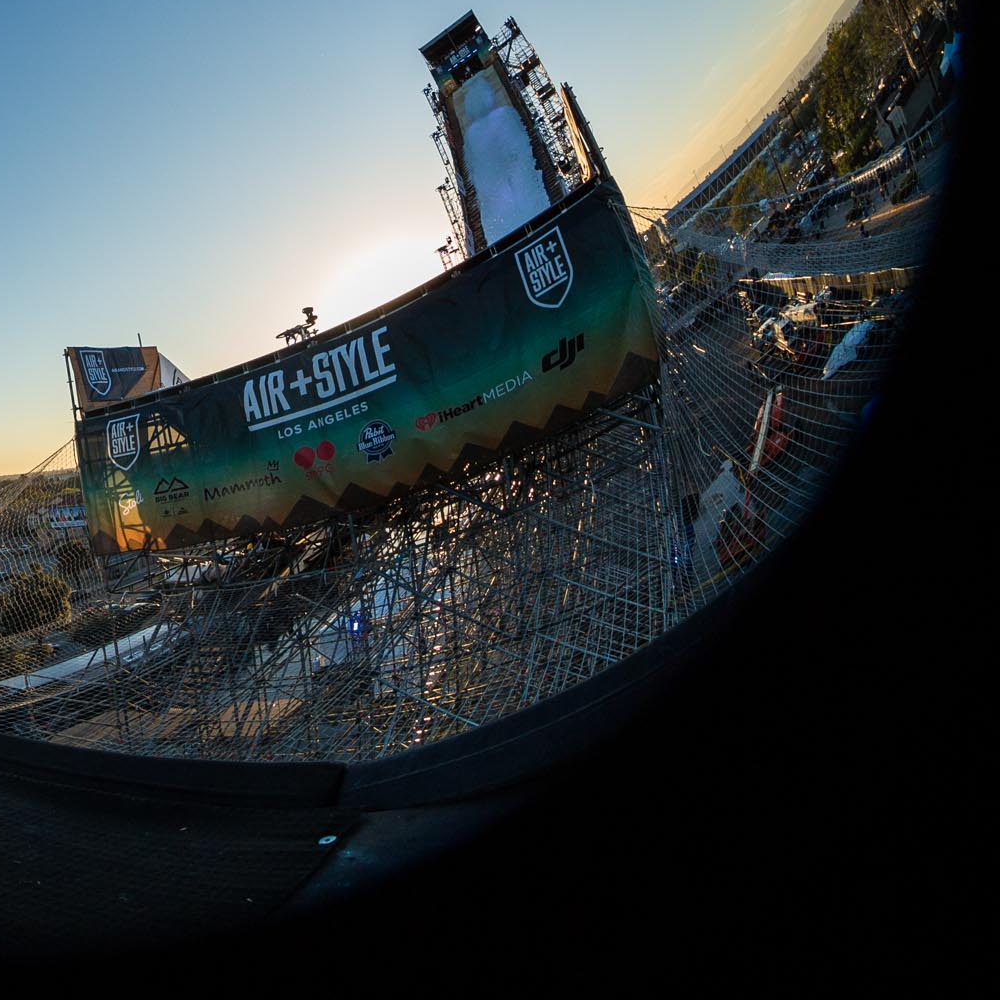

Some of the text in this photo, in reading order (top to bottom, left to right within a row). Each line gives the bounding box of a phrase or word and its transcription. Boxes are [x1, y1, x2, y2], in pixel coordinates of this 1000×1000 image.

[524, 241, 557, 273] AIR+
[529, 255, 566, 292] STYLE
[85, 354, 102, 368] AIR+
[88, 367, 108, 381] STYLE
[438, 370, 533, 423] iHeartMEDIA
[111, 421, 134, 439] AIR+
[277, 401, 369, 439] LOS ANGELES
[112, 434, 136, 455] STYLE
[358, 441, 373, 451] Blue
[372, 433, 395, 446] Ribbon
[363, 425, 385, 440] Pabst
[204, 472, 282, 502] Mammoth
[119, 489, 144, 516] Stoli
